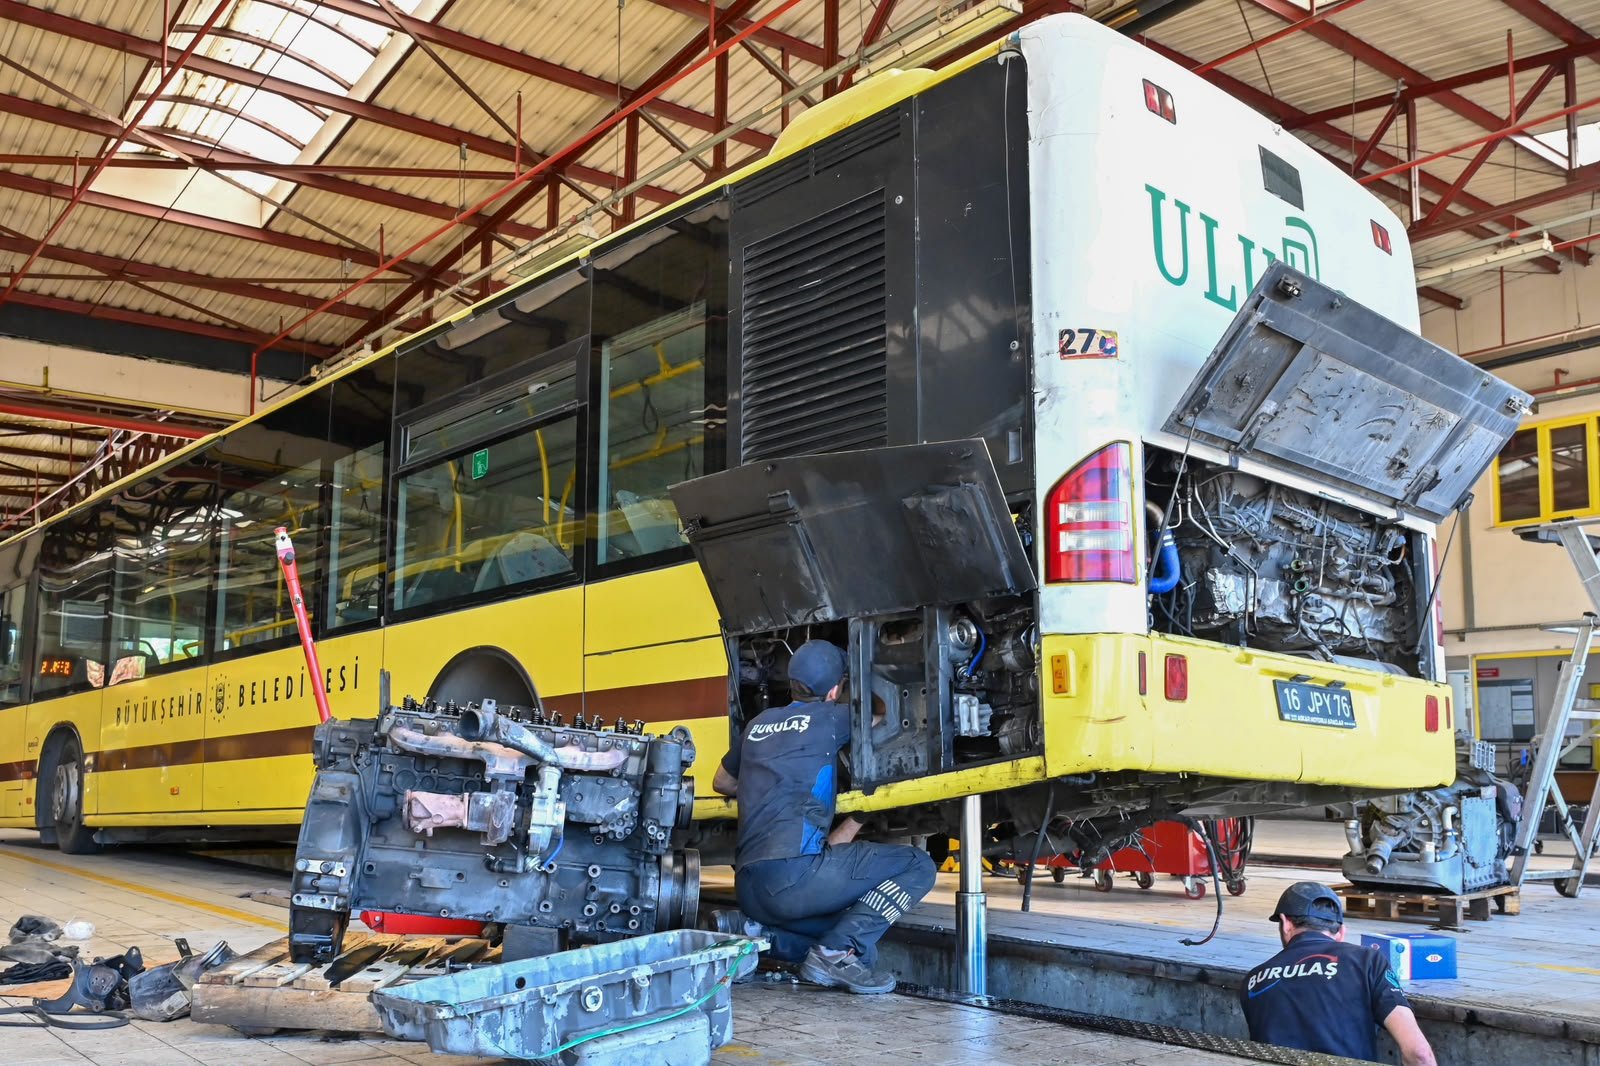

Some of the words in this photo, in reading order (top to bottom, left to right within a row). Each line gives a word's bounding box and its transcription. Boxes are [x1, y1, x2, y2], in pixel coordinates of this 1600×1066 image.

[115, 687, 202, 726] BÜYÜKŞEHİR
[238, 655, 359, 708] BELEDİESİ
[1283, 687, 1301, 711] 16
[1307, 691, 1332, 716] JPY
[1333, 694, 1351, 718] 76
[1247, 961, 1339, 991] BURULAŞ
